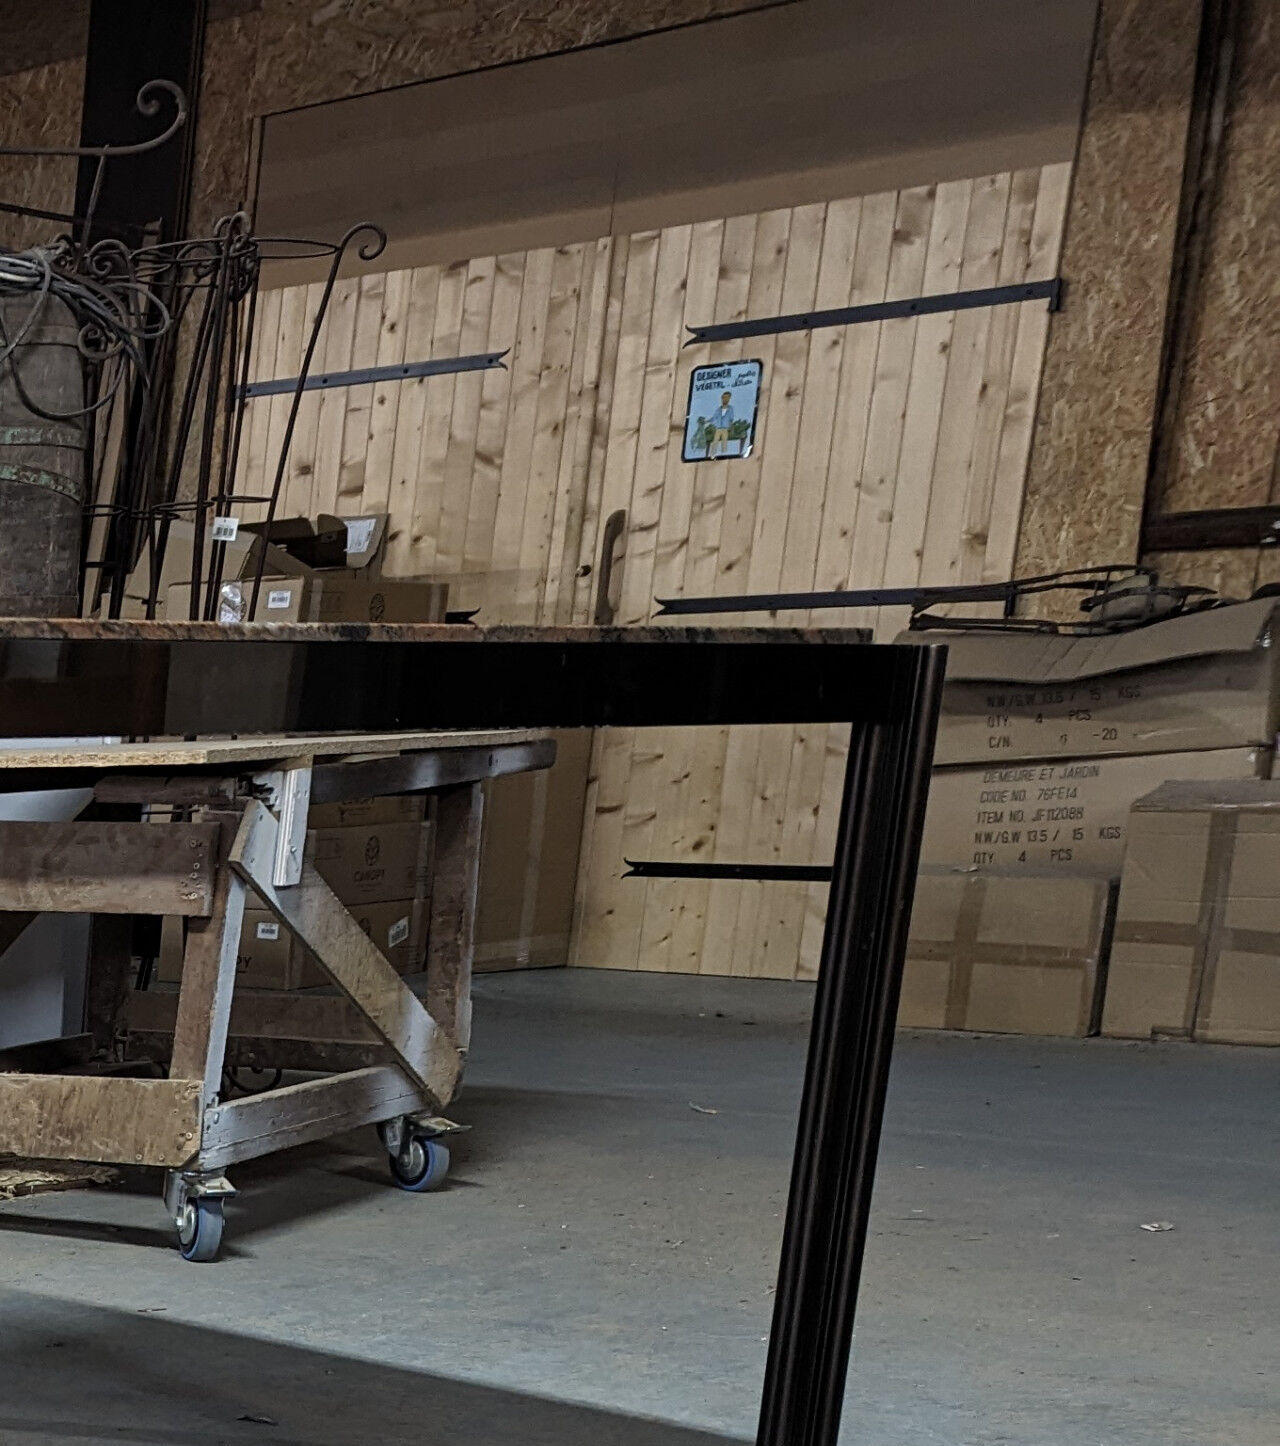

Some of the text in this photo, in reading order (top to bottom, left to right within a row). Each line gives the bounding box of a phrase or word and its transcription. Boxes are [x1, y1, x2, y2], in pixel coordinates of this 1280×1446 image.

[697, 368, 731, 381] DESIGNER
[983, 765, 1100, 783] DEMEURE ET JARDIN
[980, 789, 1008, 803] CODE
[976, 811, 1003, 824] ITEM
[1072, 828, 1084, 841] 15
[1097, 826, 1121, 840] KGS
[1018, 850, 1026, 863] 4
[1050, 848, 1072, 862] PCS
